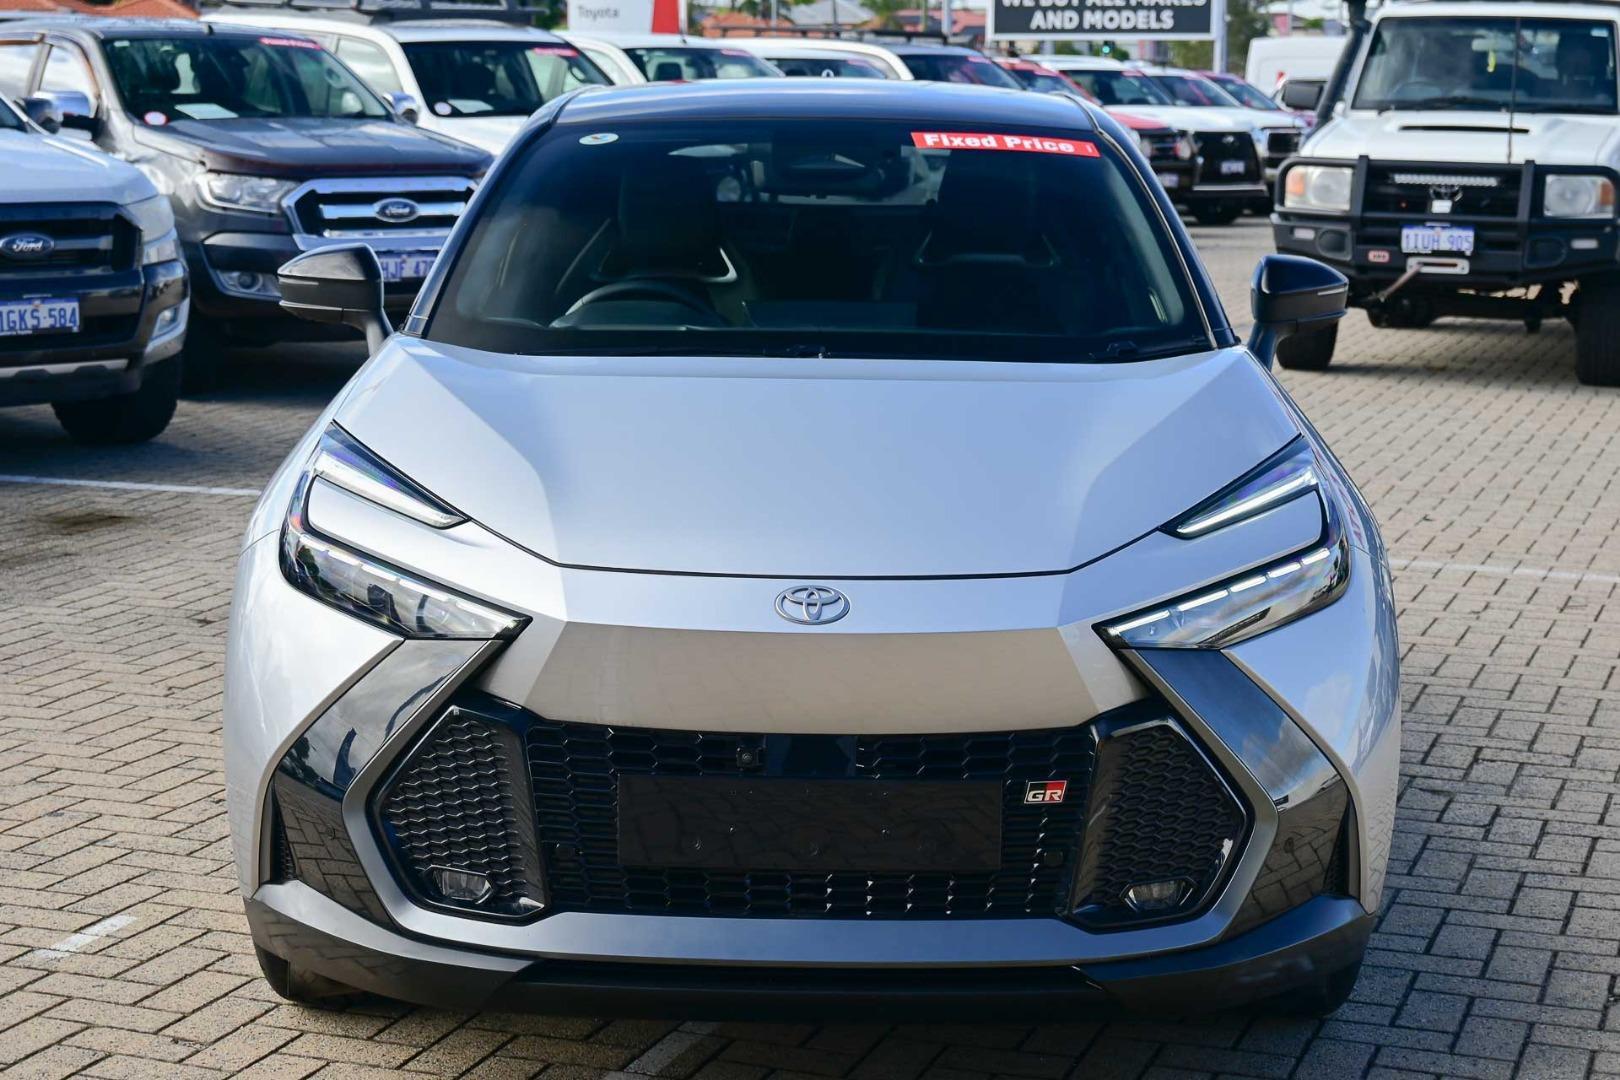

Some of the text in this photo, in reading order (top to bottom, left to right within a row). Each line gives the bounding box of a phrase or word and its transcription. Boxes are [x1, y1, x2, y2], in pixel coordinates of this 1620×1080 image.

[578, 6, 619, 20] Toyota
[1030, 9, 1175, 30] AND MODELS
[923, 133, 998, 148] Fixed
[1003, 135, 1075, 153] Price
[12, 238, 44, 252] Ford
[1027, 790, 1062, 801] GR
